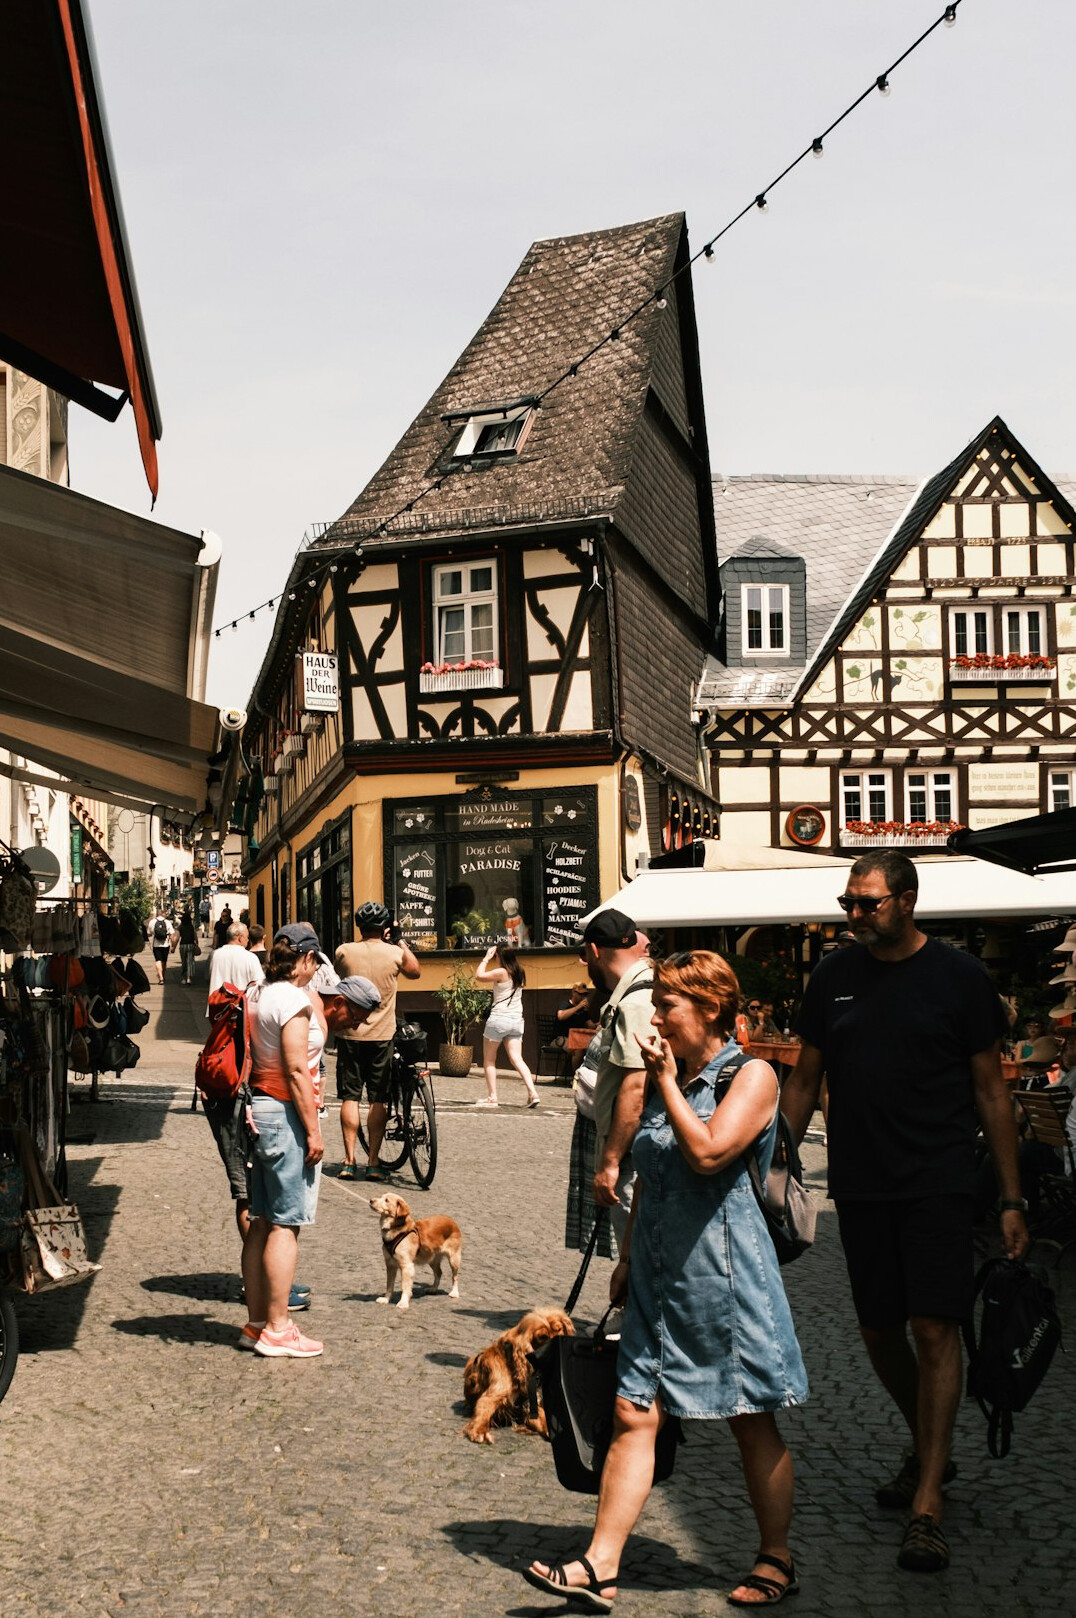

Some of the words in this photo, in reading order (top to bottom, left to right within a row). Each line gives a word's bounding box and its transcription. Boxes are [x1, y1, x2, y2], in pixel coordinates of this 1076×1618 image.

[306, 656, 336, 669] HAUS
[312, 669, 330, 678] DER
[306, 678, 337, 694] Weine
[459, 804, 488, 815] HAND
[490, 803, 519, 812] MADE
[466, 846, 486, 857] Dog
[495, 844, 511, 854] Cat
[561, 841, 587, 855] Decken
[210, 853, 217, 863] P
[400, 852, 420, 867] Jacken
[555, 857, 583, 866] HOLZBETT
[460, 859, 522, 874] PARADISE
[414, 870, 433, 878] FUTTER
[408, 882, 430, 893] GRÜNE
[547, 886, 581, 894] HOODIES
[403, 888, 437, 902] APOTHEKE
[560, 897, 587, 909] PYJAMAS
[410, 918, 435, 927] T-SHIRTS
[464, 935, 486, 944] Mary
[494, 934, 519, 944] Jessie
